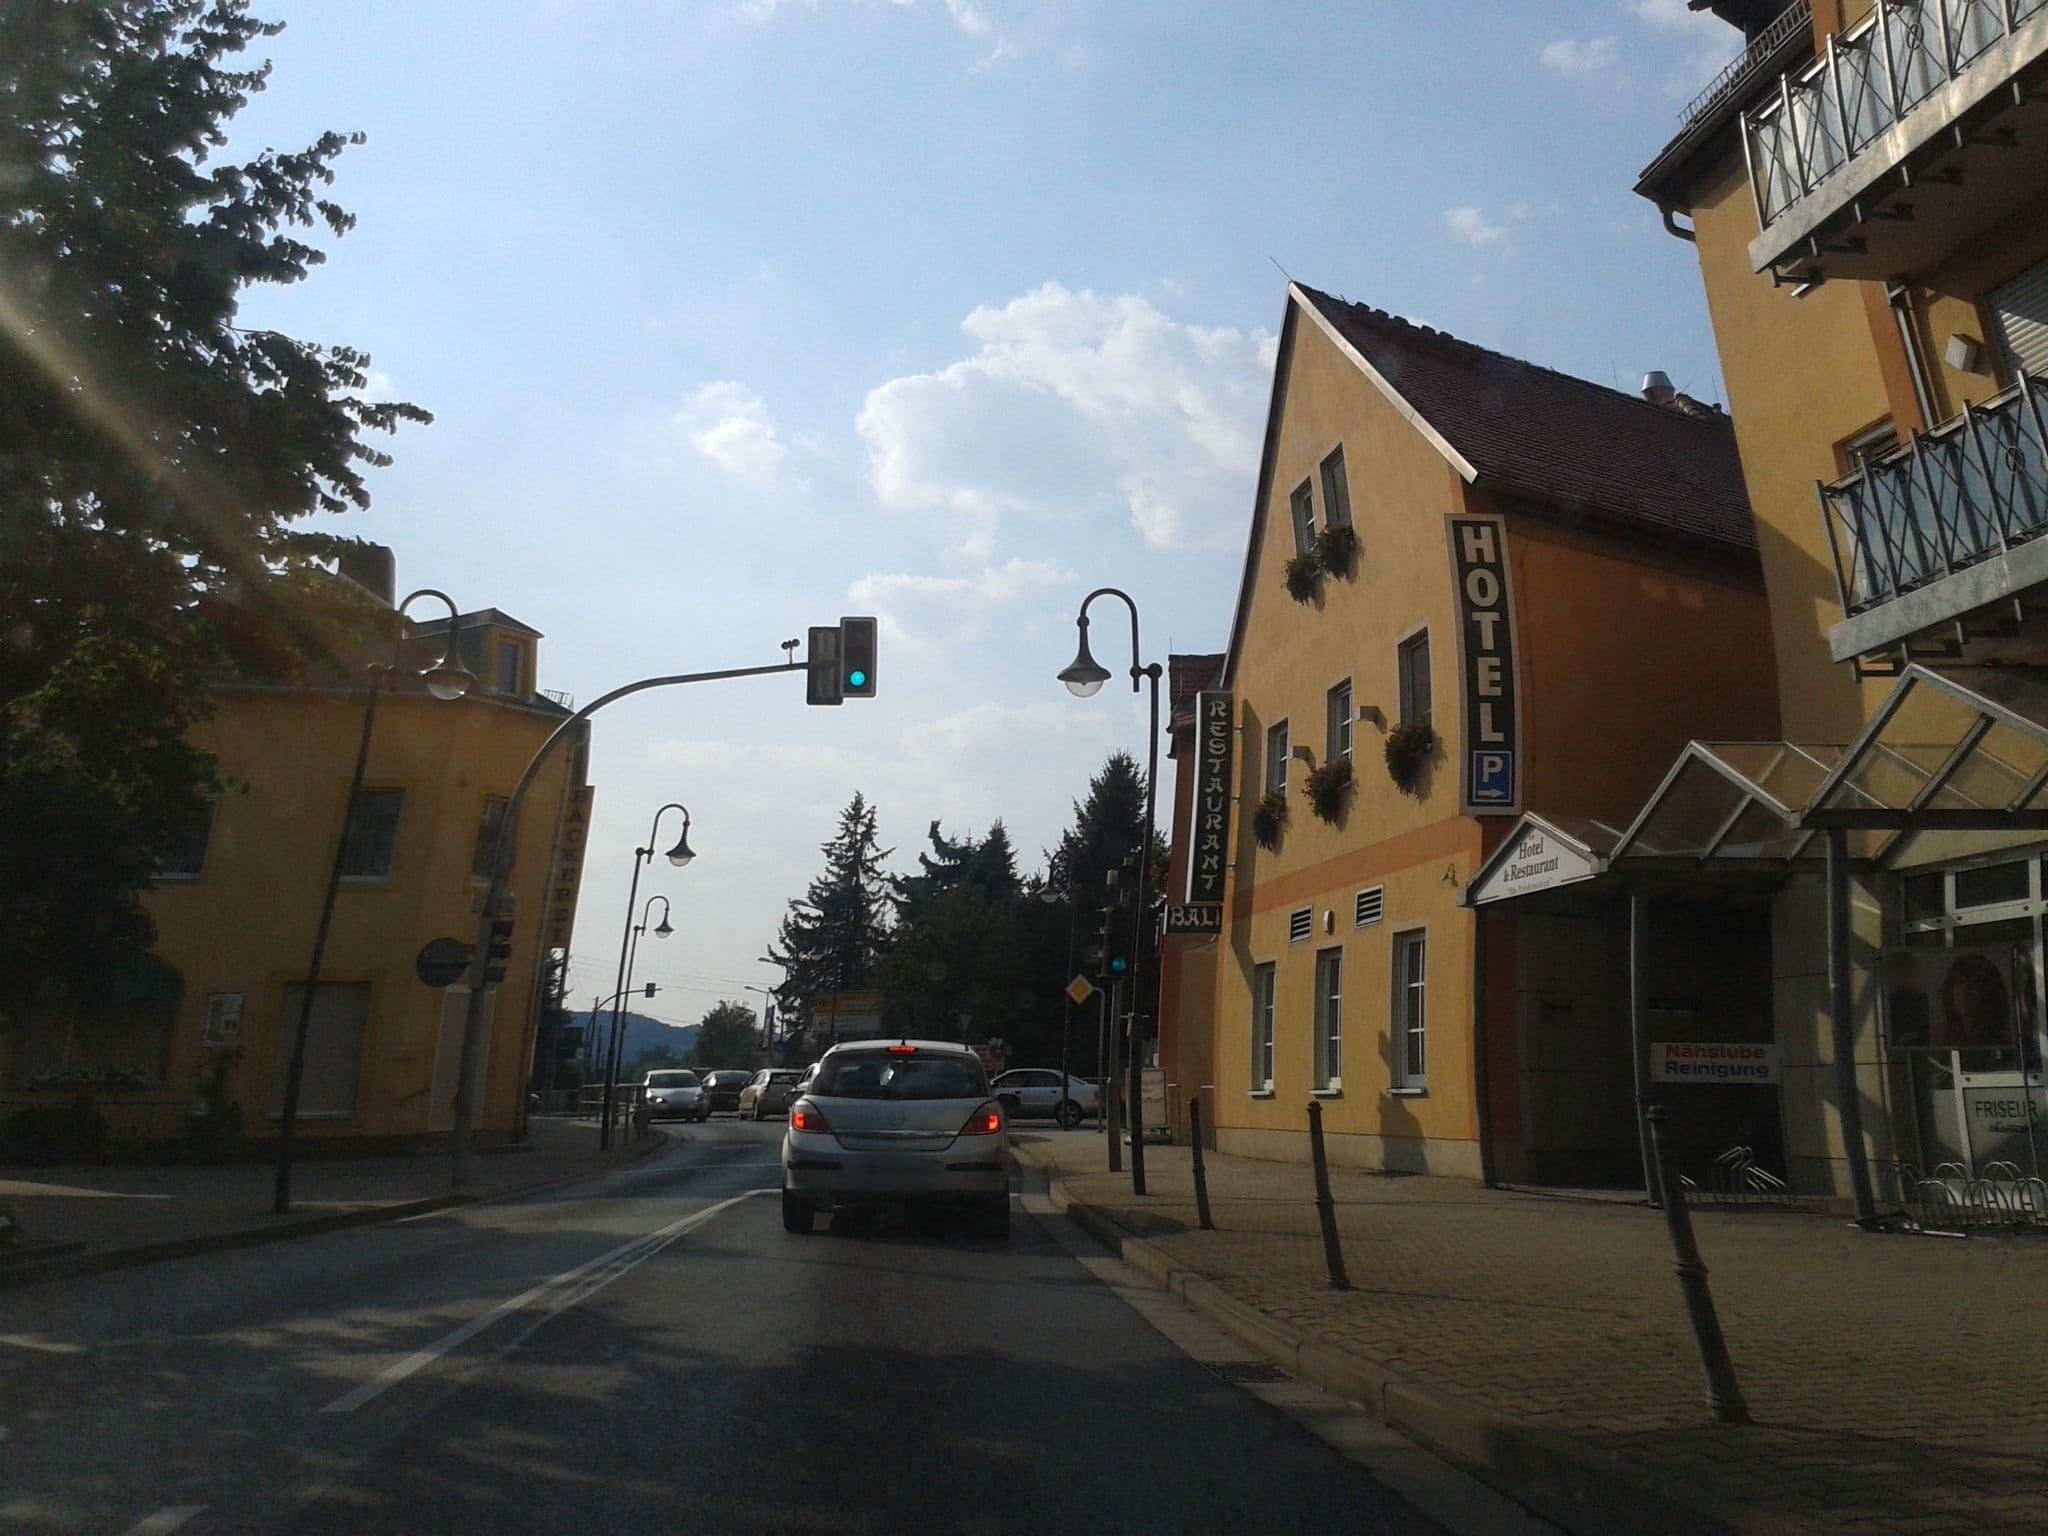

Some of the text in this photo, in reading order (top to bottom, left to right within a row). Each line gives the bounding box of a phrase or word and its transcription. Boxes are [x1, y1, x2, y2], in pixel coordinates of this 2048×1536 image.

[1461, 524, 1505, 743] HOTEL
[1482, 755, 1504, 784] P
[1200, 700, 1228, 891] RESTAURANT
[1518, 837, 1544, 861] Hotel
[1511, 856, 1559, 882] Restaurant
[1169, 907, 1221, 928] BALI
[1665, 1044, 1766, 1059] Nähstube
[1664, 1061, 1770, 1078] Reinigung
[1975, 1100, 2040, 1119] FRISEUR
